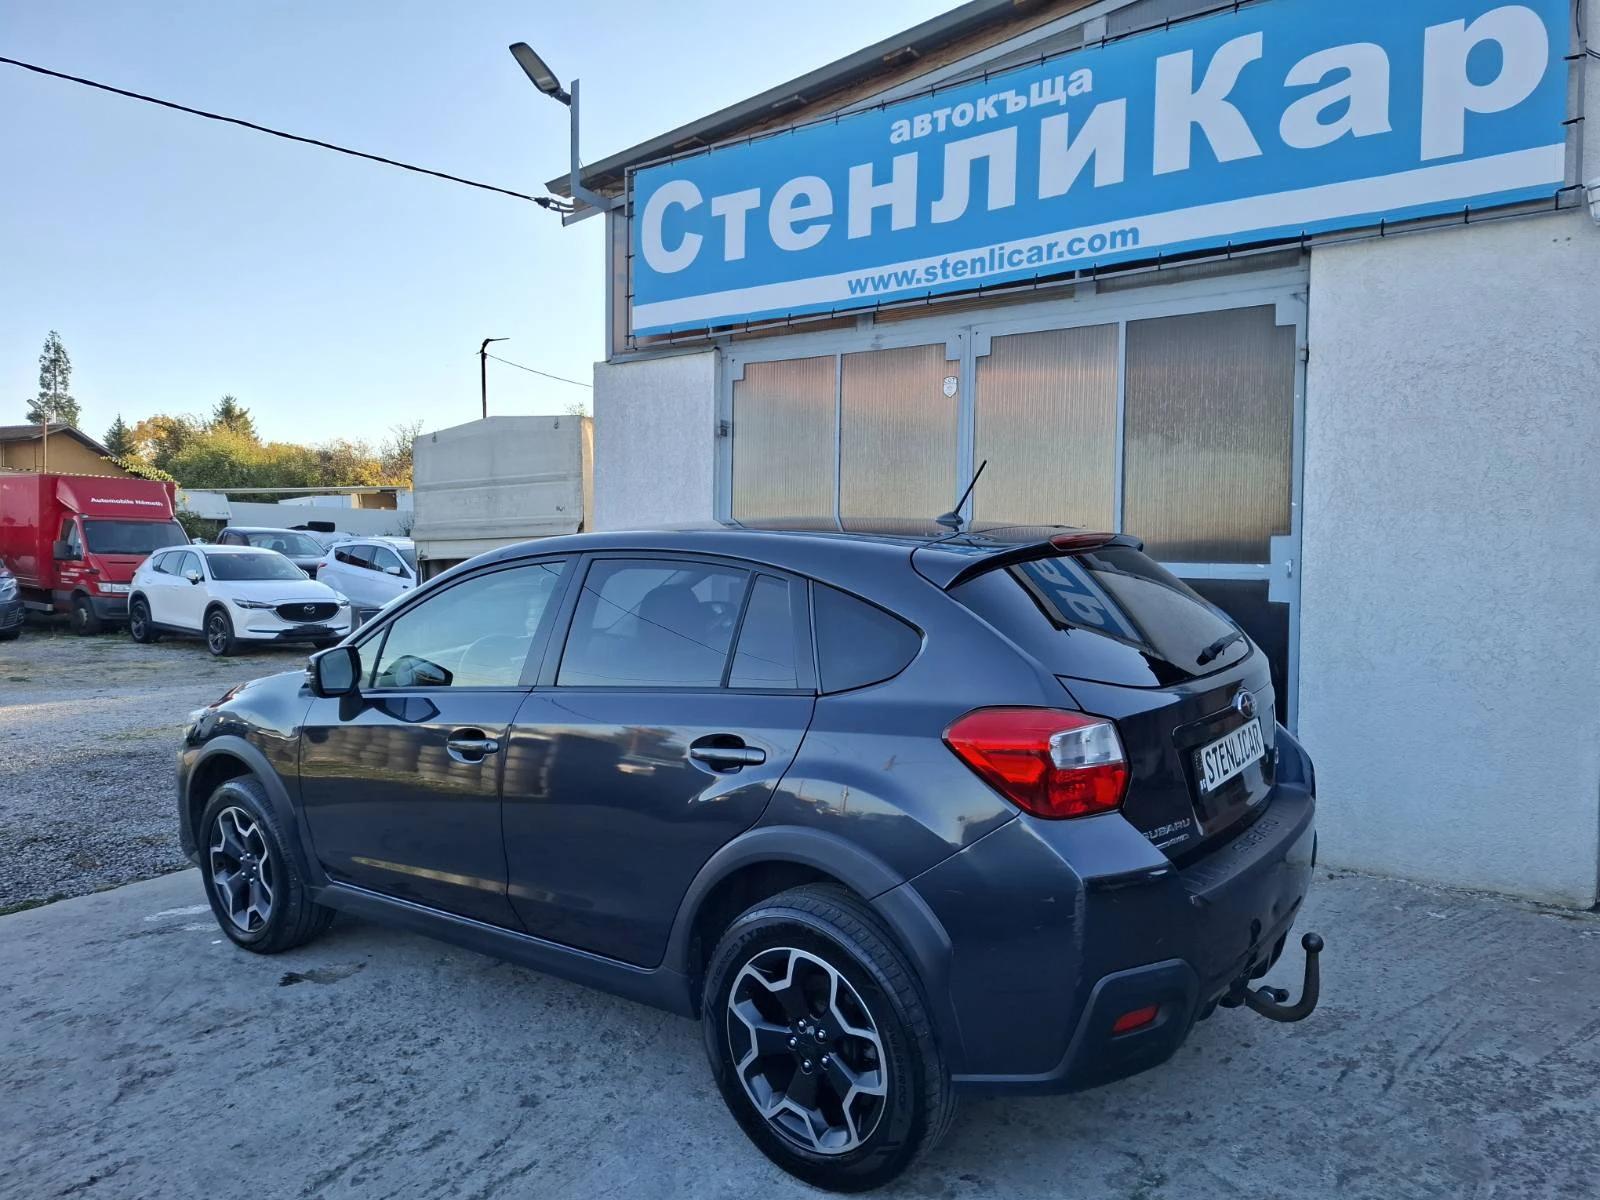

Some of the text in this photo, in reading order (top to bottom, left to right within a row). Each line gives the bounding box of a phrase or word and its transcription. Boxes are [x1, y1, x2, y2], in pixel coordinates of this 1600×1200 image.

[640, 4, 1550, 275] СтенлиКар
[889, 67, 1094, 145] автокъща
[847, 225, 1140, 296] www.stenlicar.com
[1204, 723, 1262, 785] STENLICAR
[1143, 817, 1191, 840] SUBARU
